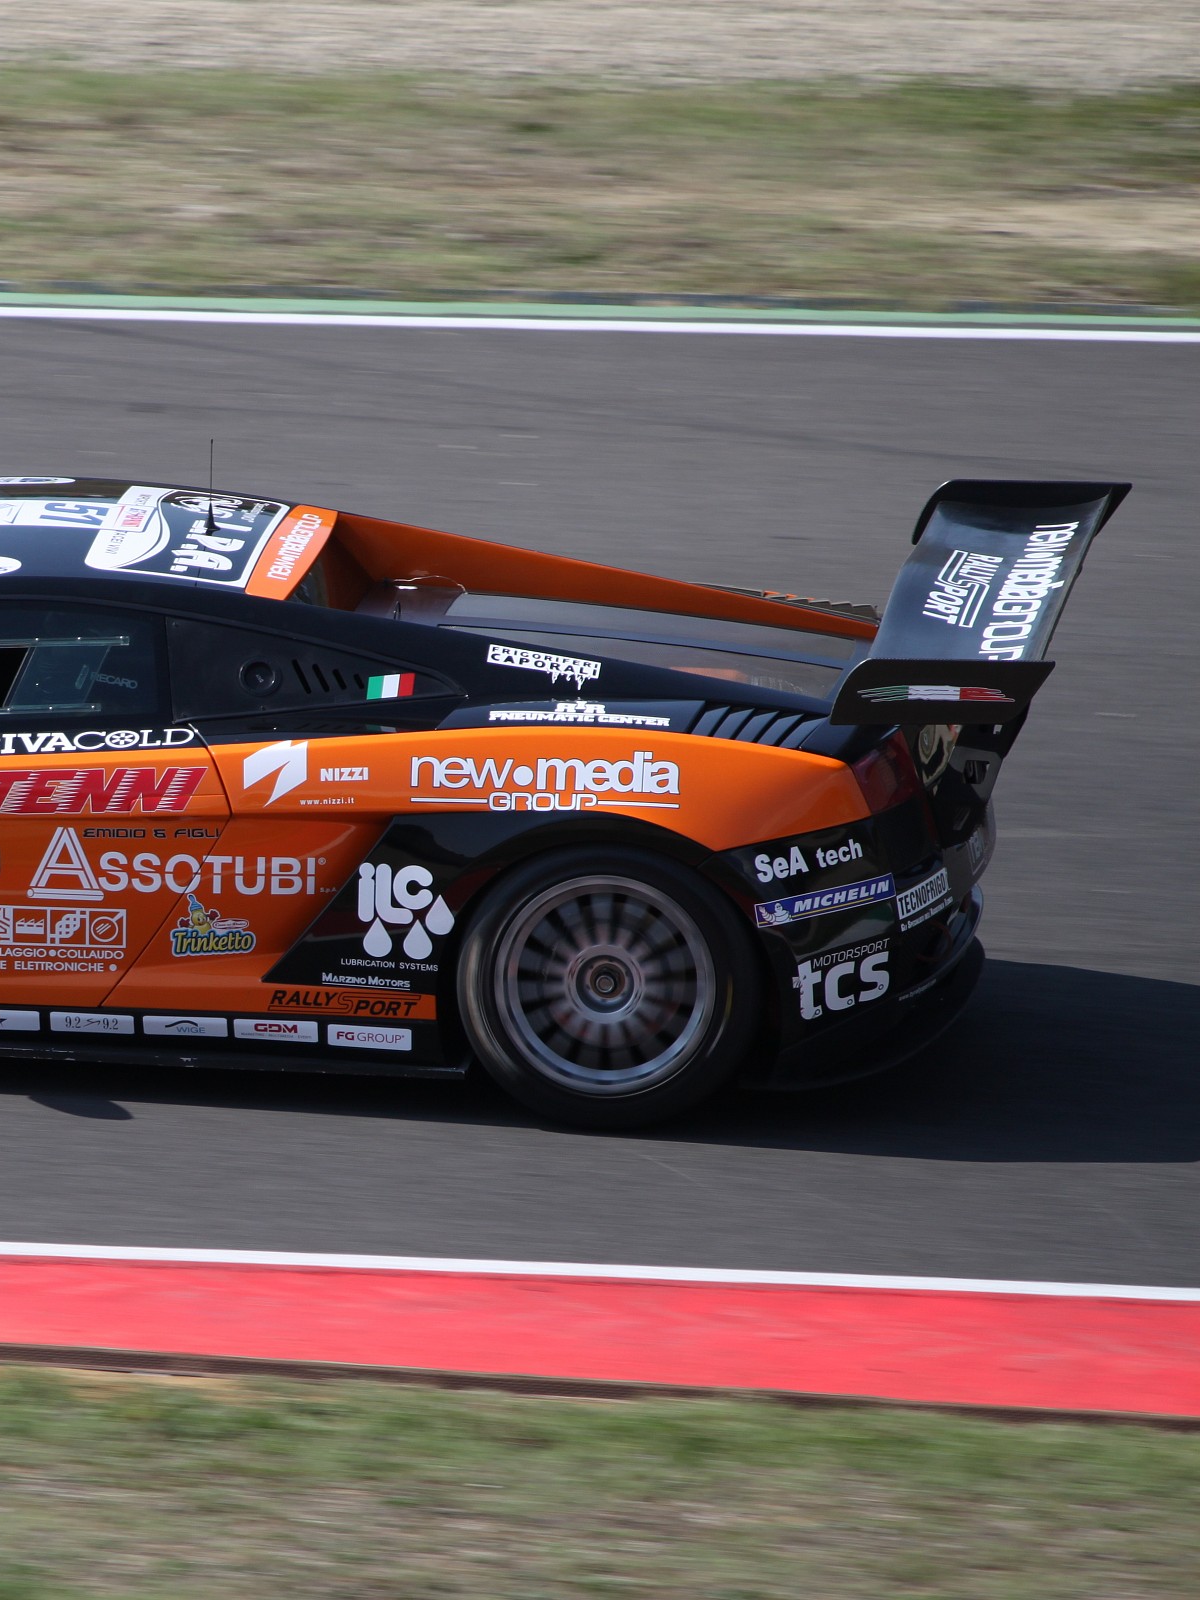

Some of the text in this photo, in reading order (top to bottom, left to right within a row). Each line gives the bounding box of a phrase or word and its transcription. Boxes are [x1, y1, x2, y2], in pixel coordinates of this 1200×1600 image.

[39, 502, 110, 526] 51
[490, 653, 598, 677] CAPORALI
[492, 646, 599, 669] FRIGORIFERI
[488, 711, 671, 727] PNEUMATIC CENTER
[320, 767, 369, 782] NIZZI
[300, 797, 355, 806] www.nizzi.it
[488, 792, 598, 812] GROUP
[83, 828, 146, 838] EMIDIO
[174, 828, 219, 838] FIGLI
[754, 838, 863, 883] SeA tech
[793, 879, 890, 914] MICHELIN
[898, 872, 947, 917] TECNOFRIGO
[173, 931, 254, 954] Trinketto
[57, 950, 125, 960] COLLAUDO
[813, 938, 890, 969] MOTORSPORT
[14, 961, 105, 972] ELETTRONICHE
[340, 958, 439, 972] LUBRICATION SYSTEMS
[798, 951, 890, 1020] tcs
[268, 989, 422, 1017] RALLYSPORT
[65, 1016, 119, 1030] 9.2 9.2
[176, 1026, 206, 1034] WIGE
[254, 1023, 298, 1034] GDM
[336, 1031, 402, 1044] FG GROUP
